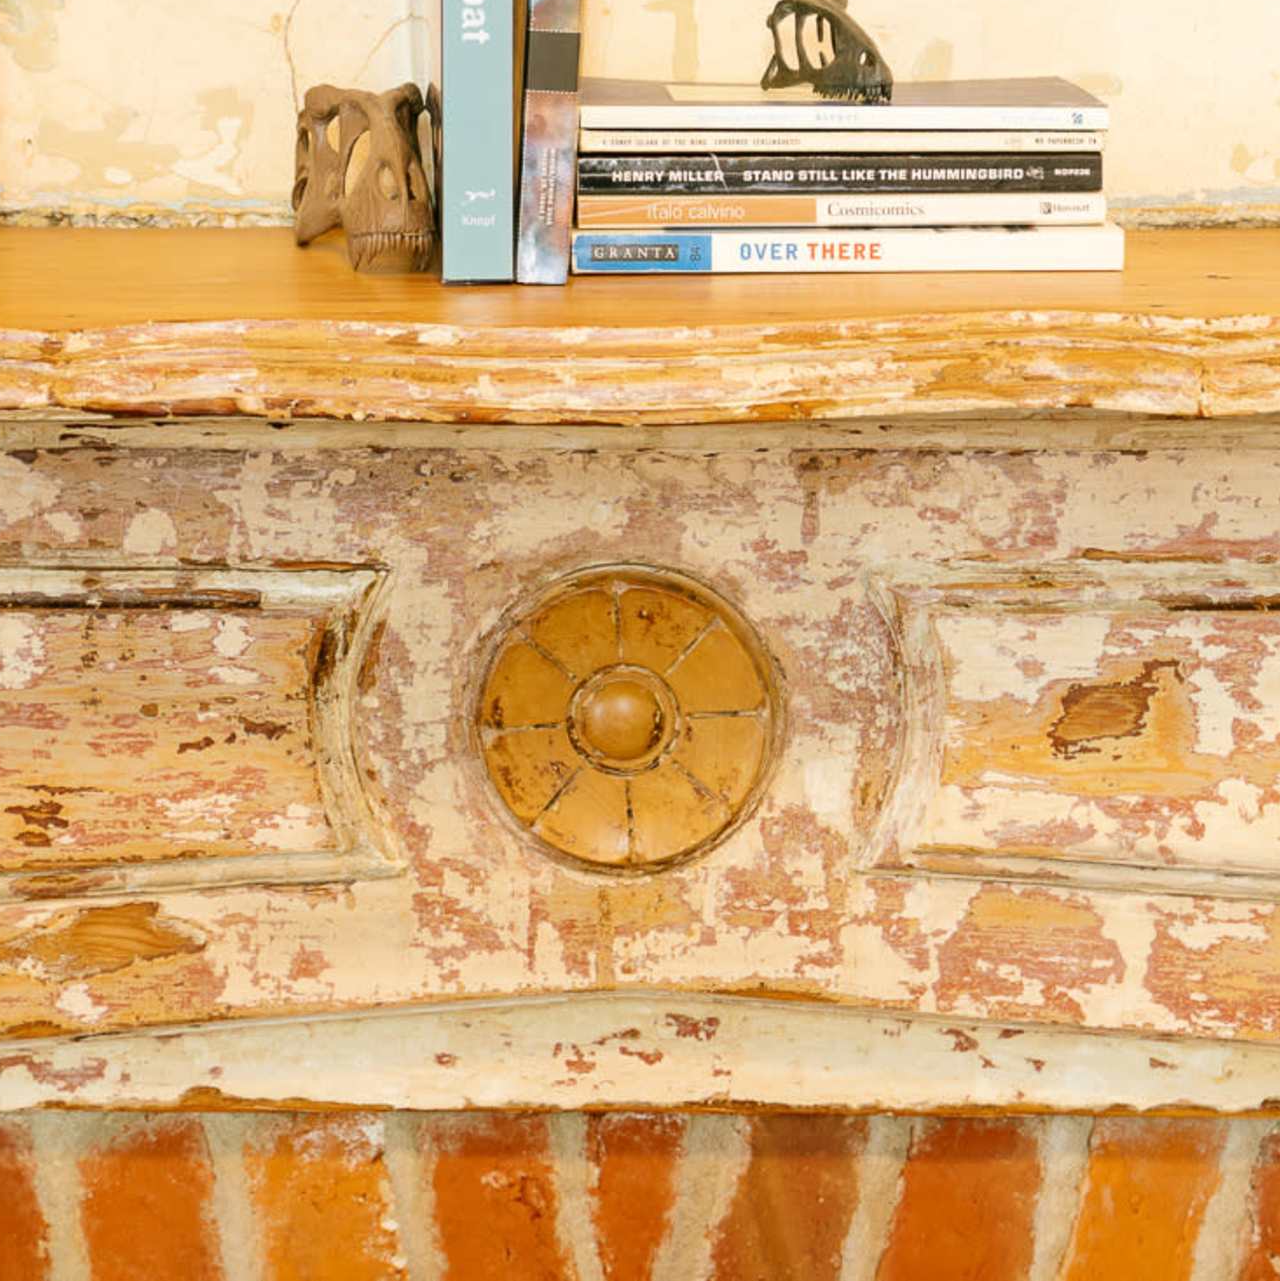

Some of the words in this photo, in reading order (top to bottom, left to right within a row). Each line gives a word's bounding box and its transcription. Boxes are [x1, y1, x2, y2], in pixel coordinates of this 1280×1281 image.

[611, 169, 664, 183] HENRY
[667, 169, 725, 184] MILLER
[742, 169, 794, 183] STAND
[797, 169, 839, 182] STILL
[841, 169, 876, 182] LIKE
[878, 168, 909, 181] THE
[910, 167, 1024, 182] HUMMINGBIRD
[826, 200, 925, 217] Cosmicomics
[593, 244, 678, 261] GRANTA
[739, 242, 798, 261] OVER
[807, 242, 882, 261] THERE
